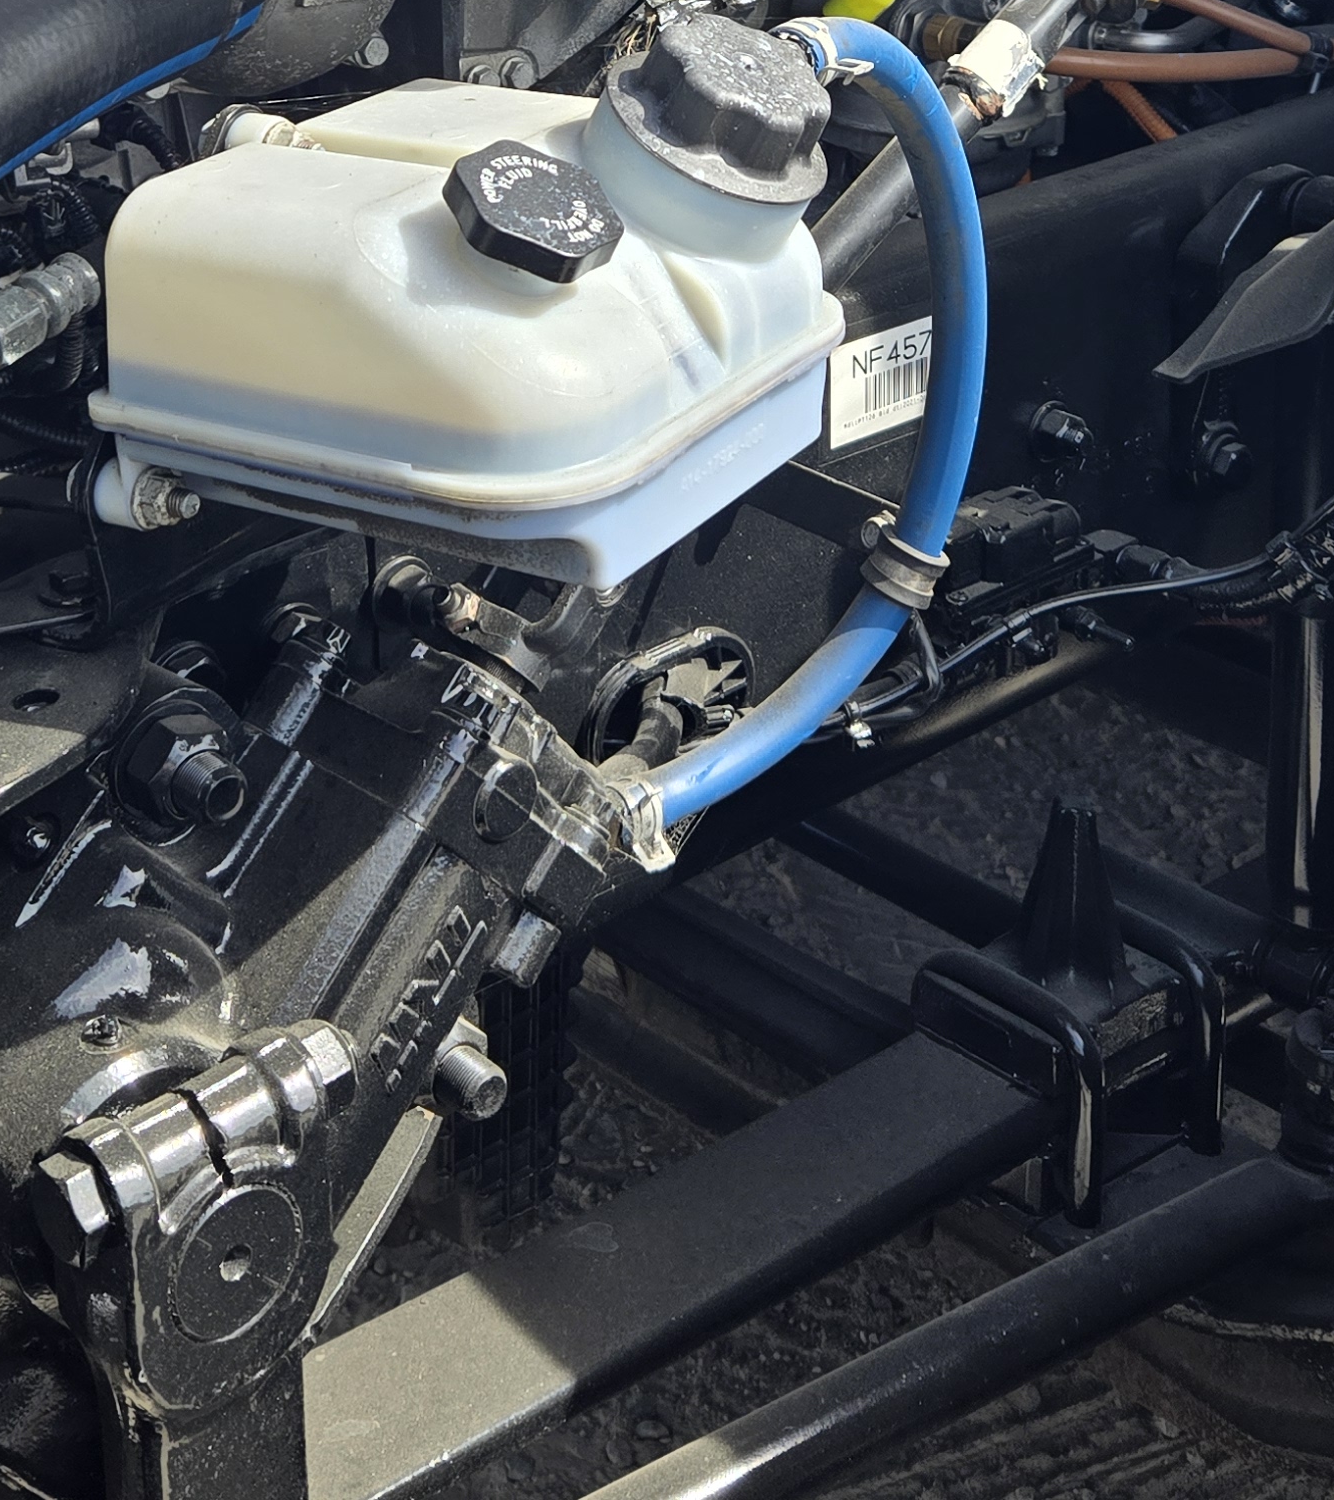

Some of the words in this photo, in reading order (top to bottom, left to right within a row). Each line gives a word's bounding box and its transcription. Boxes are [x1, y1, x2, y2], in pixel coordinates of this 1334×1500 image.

[490, 155, 559, 176] STEERING
[480, 167, 504, 203] POWER
[498, 167, 533, 189] FLUID
[539, 200, 588, 231] OVERFILL
[588, 217, 605, 233] DO
[567, 229, 593, 242] NOT
